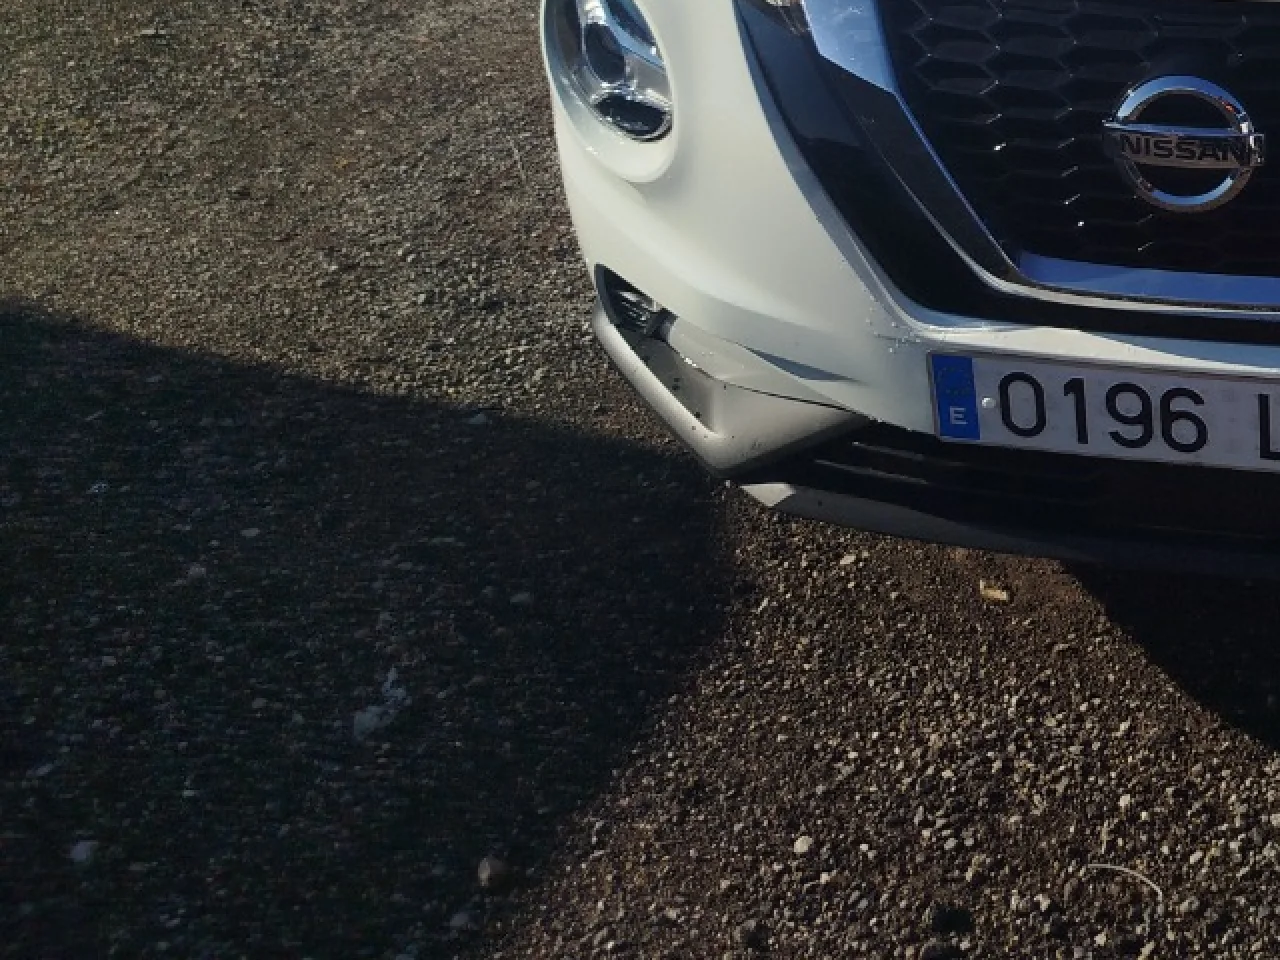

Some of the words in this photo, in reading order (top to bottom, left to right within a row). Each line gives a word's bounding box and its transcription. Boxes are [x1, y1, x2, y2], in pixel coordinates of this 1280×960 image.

[1119, 134, 1252, 163] NISSAN
[949, 406, 968, 425] E
[998, 371, 1208, 453] 0196
